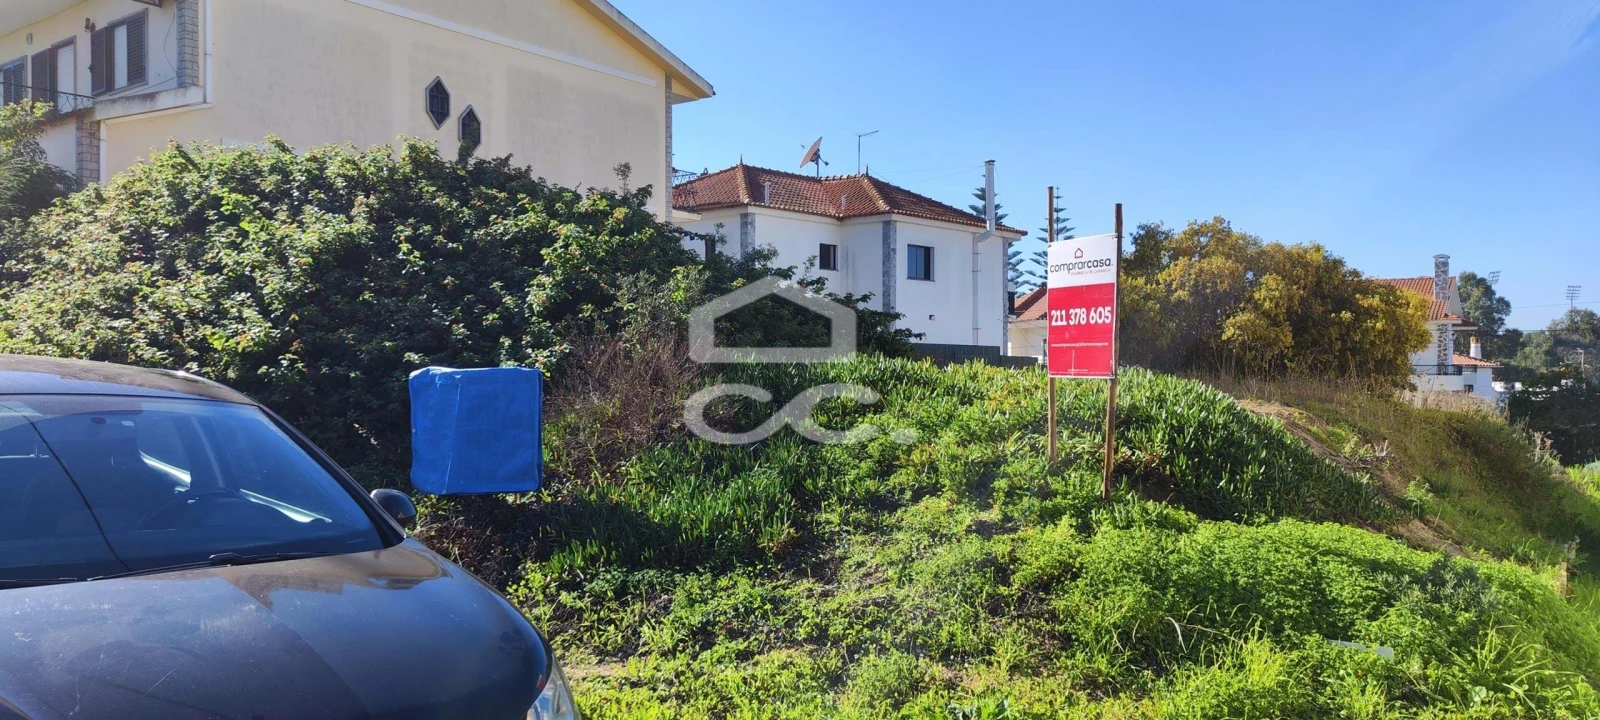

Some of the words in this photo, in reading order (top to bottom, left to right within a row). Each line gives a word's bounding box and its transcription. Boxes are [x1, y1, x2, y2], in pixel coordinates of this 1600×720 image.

[1051, 309, 1067, 326] 211
[1069, 307, 1087, 326] 378
[1089, 306, 1112, 324] 605
